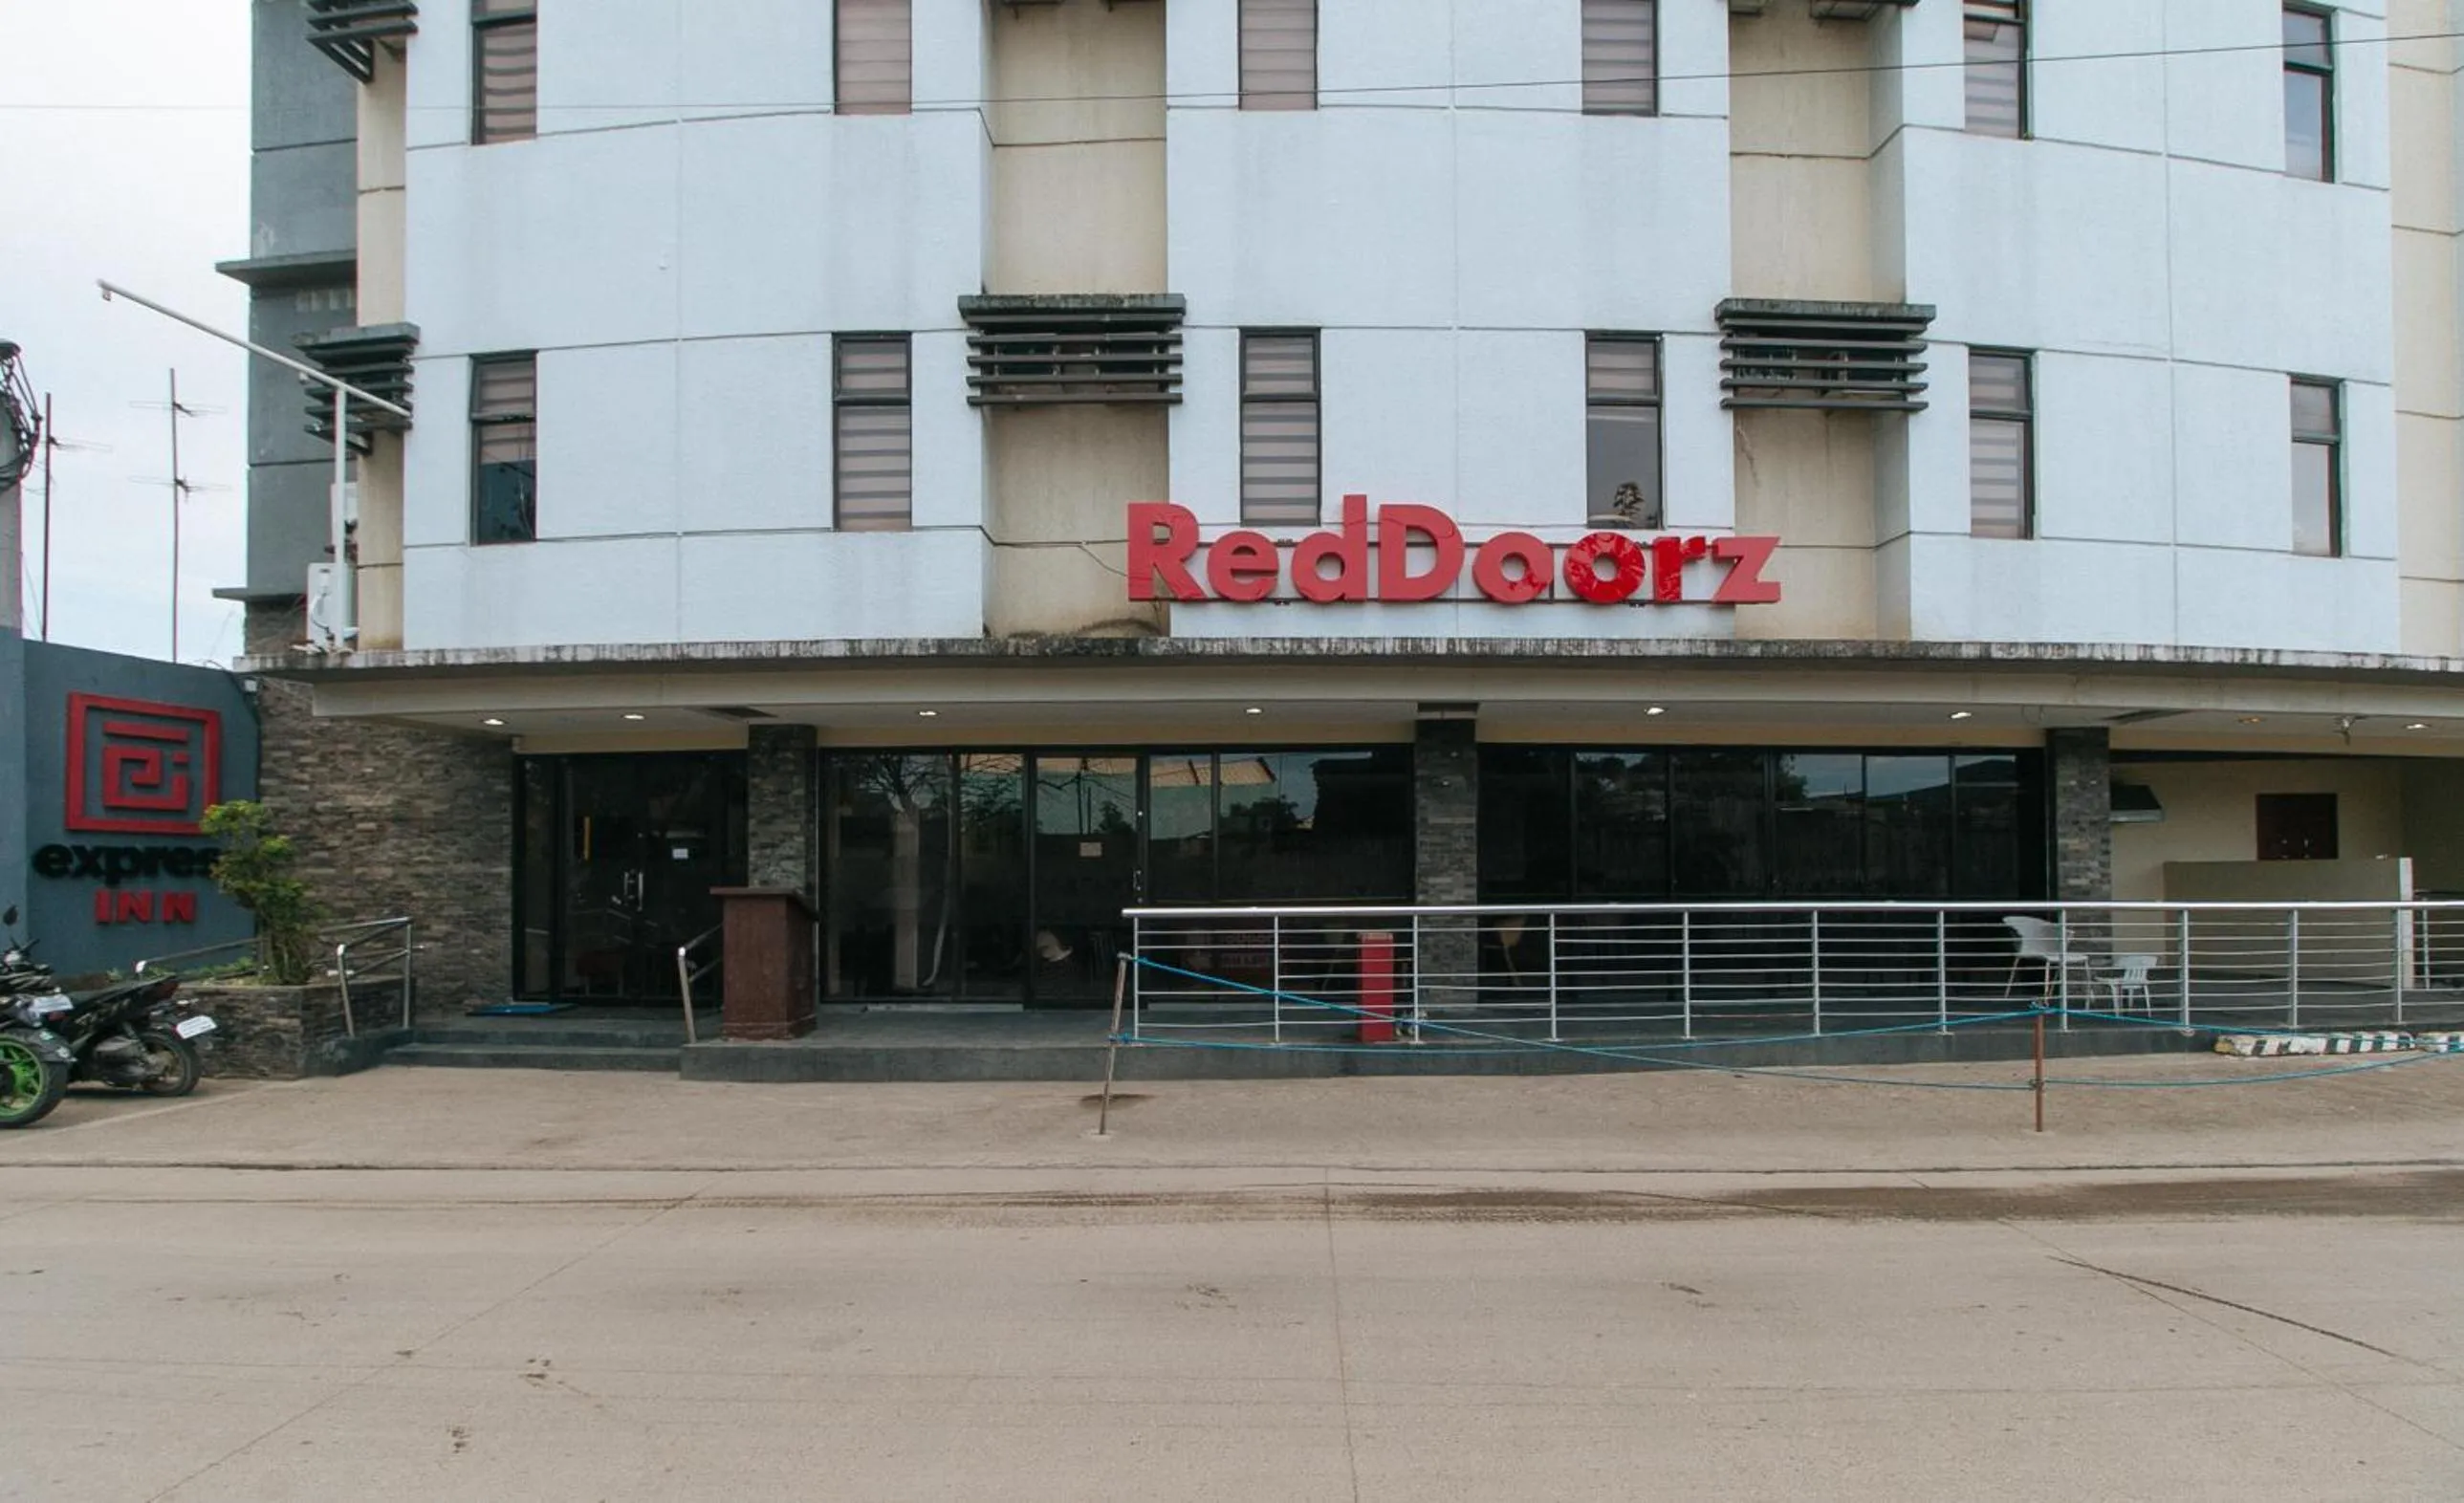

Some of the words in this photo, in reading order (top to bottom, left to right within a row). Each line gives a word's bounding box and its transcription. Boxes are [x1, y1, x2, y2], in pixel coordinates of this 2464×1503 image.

[1127, 494, 1781, 603] RedDoorz
[33, 843, 222, 887] expres
[96, 889, 196, 925] INN
